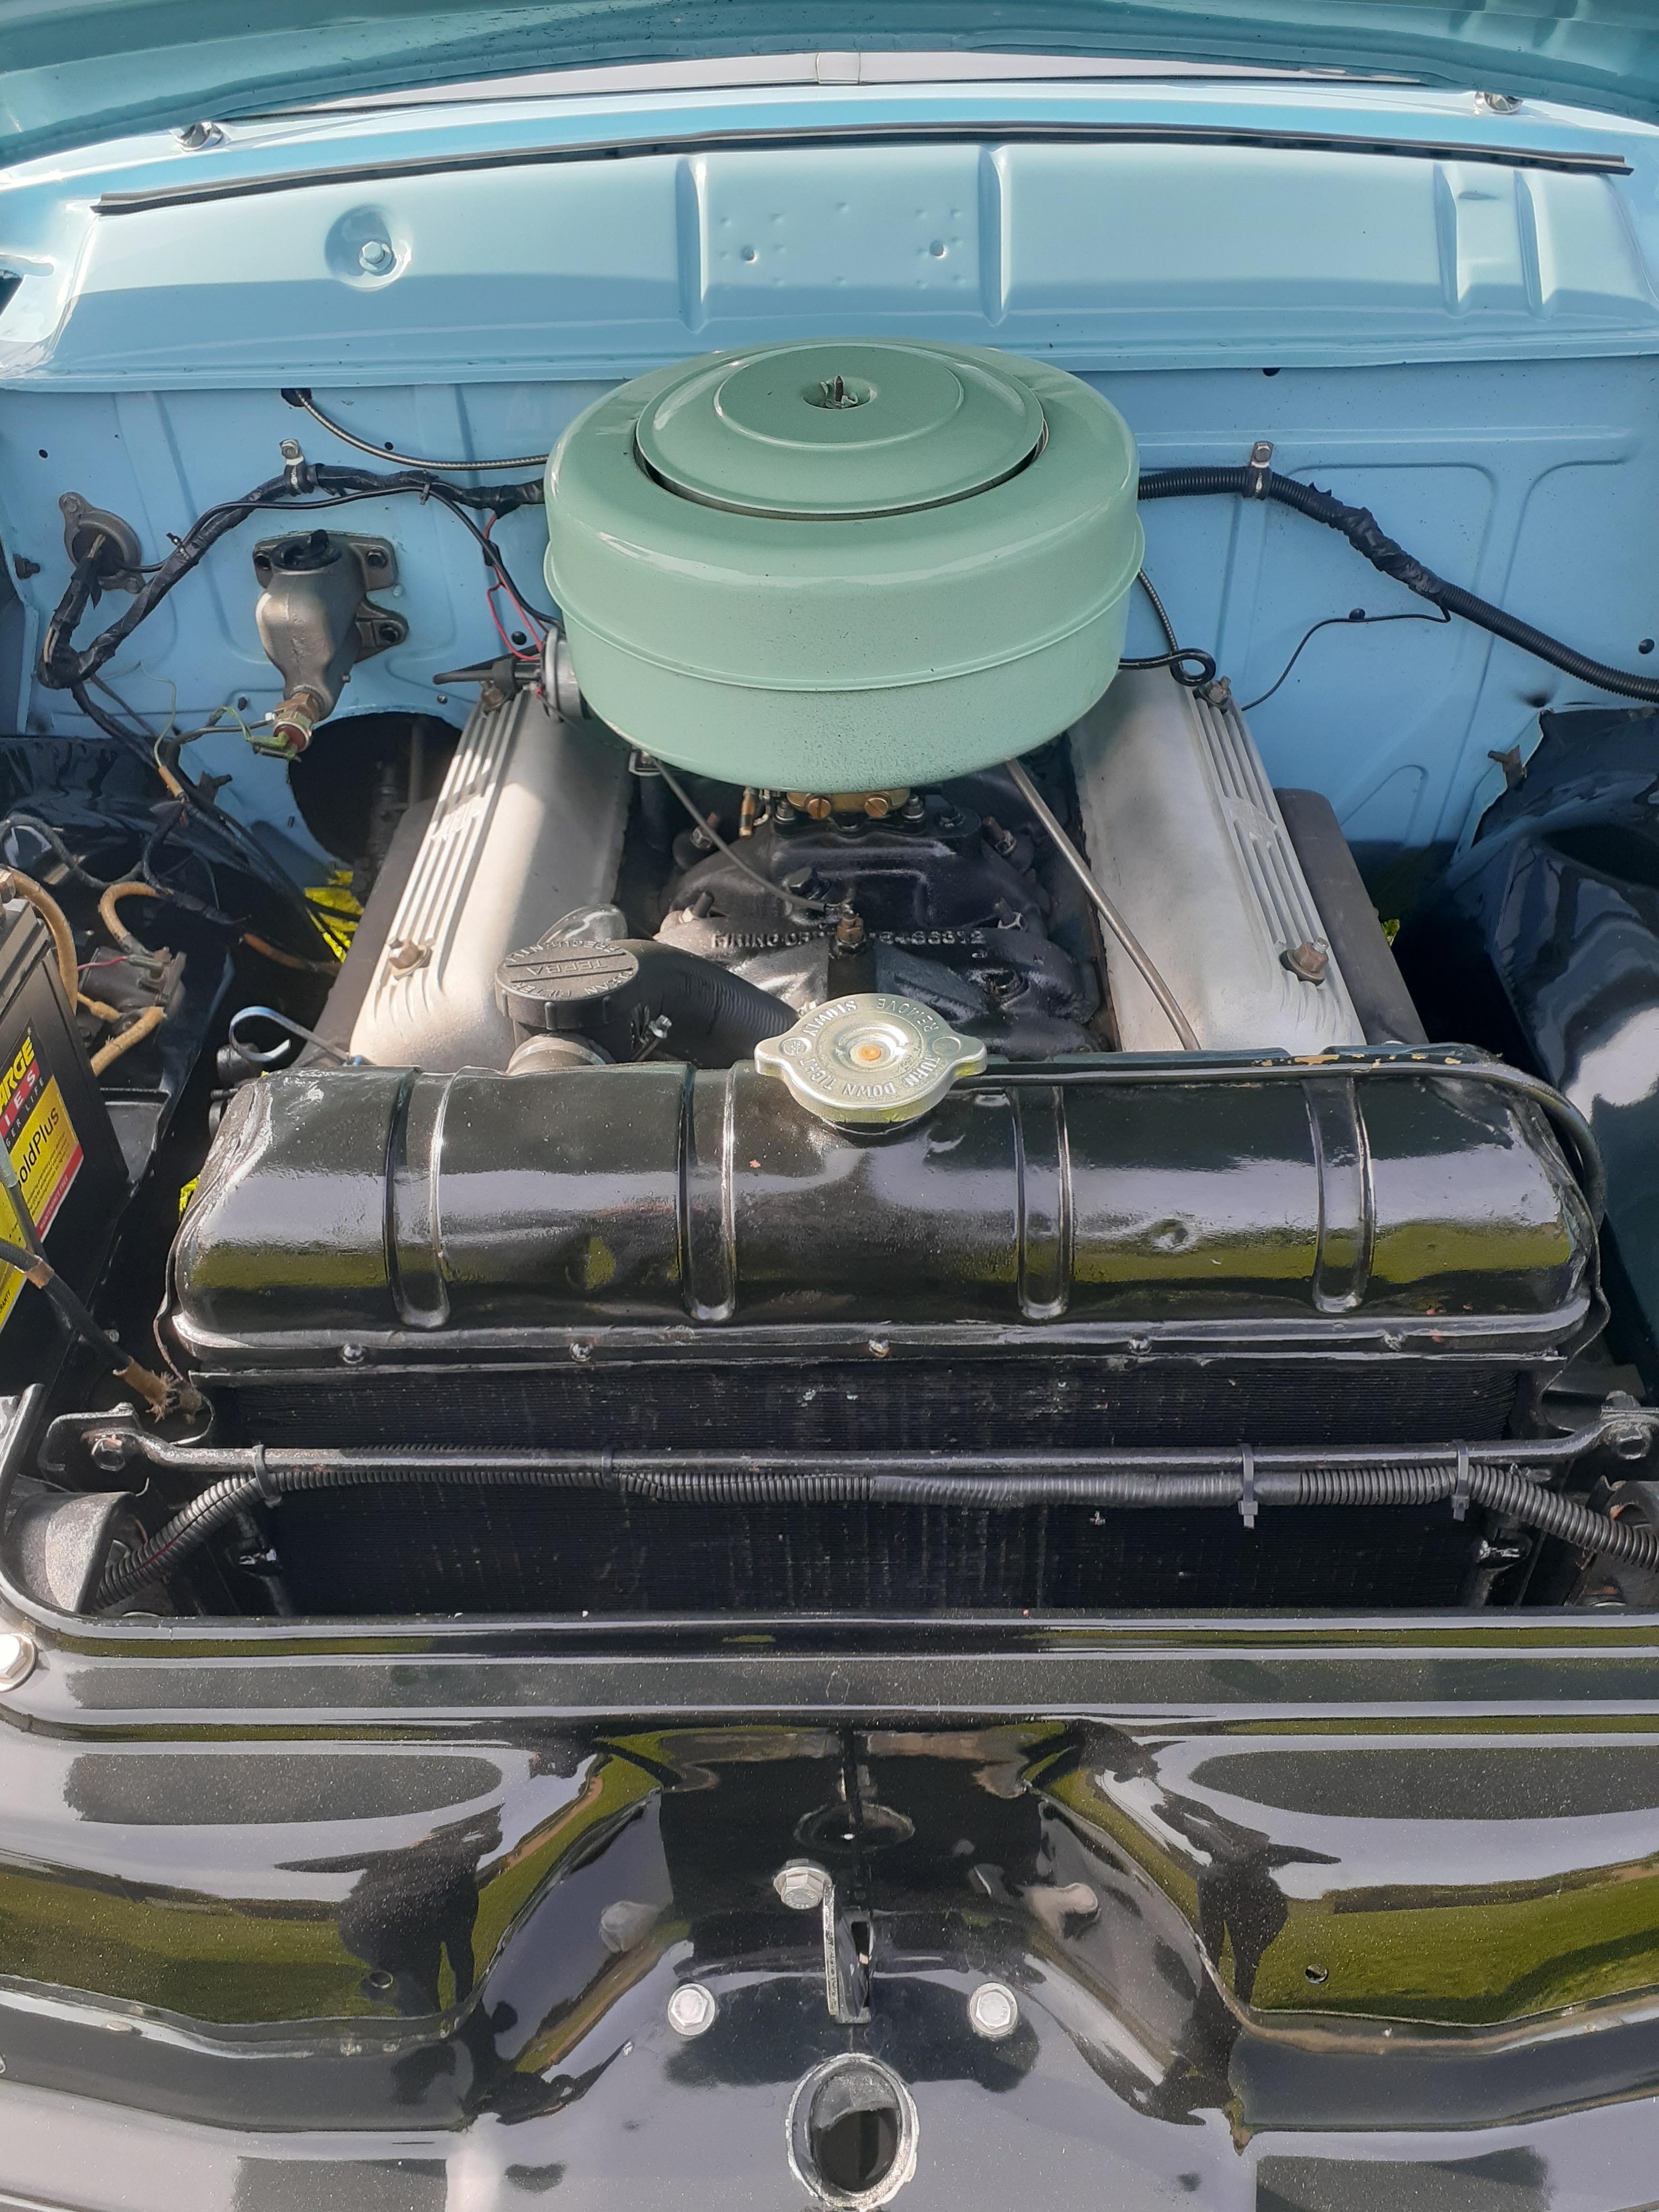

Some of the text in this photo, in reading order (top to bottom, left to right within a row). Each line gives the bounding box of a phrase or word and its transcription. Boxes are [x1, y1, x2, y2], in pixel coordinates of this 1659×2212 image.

[526, 959, 608, 975] TEFBA
[512, 982, 572, 997] FILTER
[802, 998, 939, 1037] REMOVE SLOWLY
[799, 1054, 941, 1097] TURN DOWN TIGHT
[25, 1077, 44, 1112] LIFE
